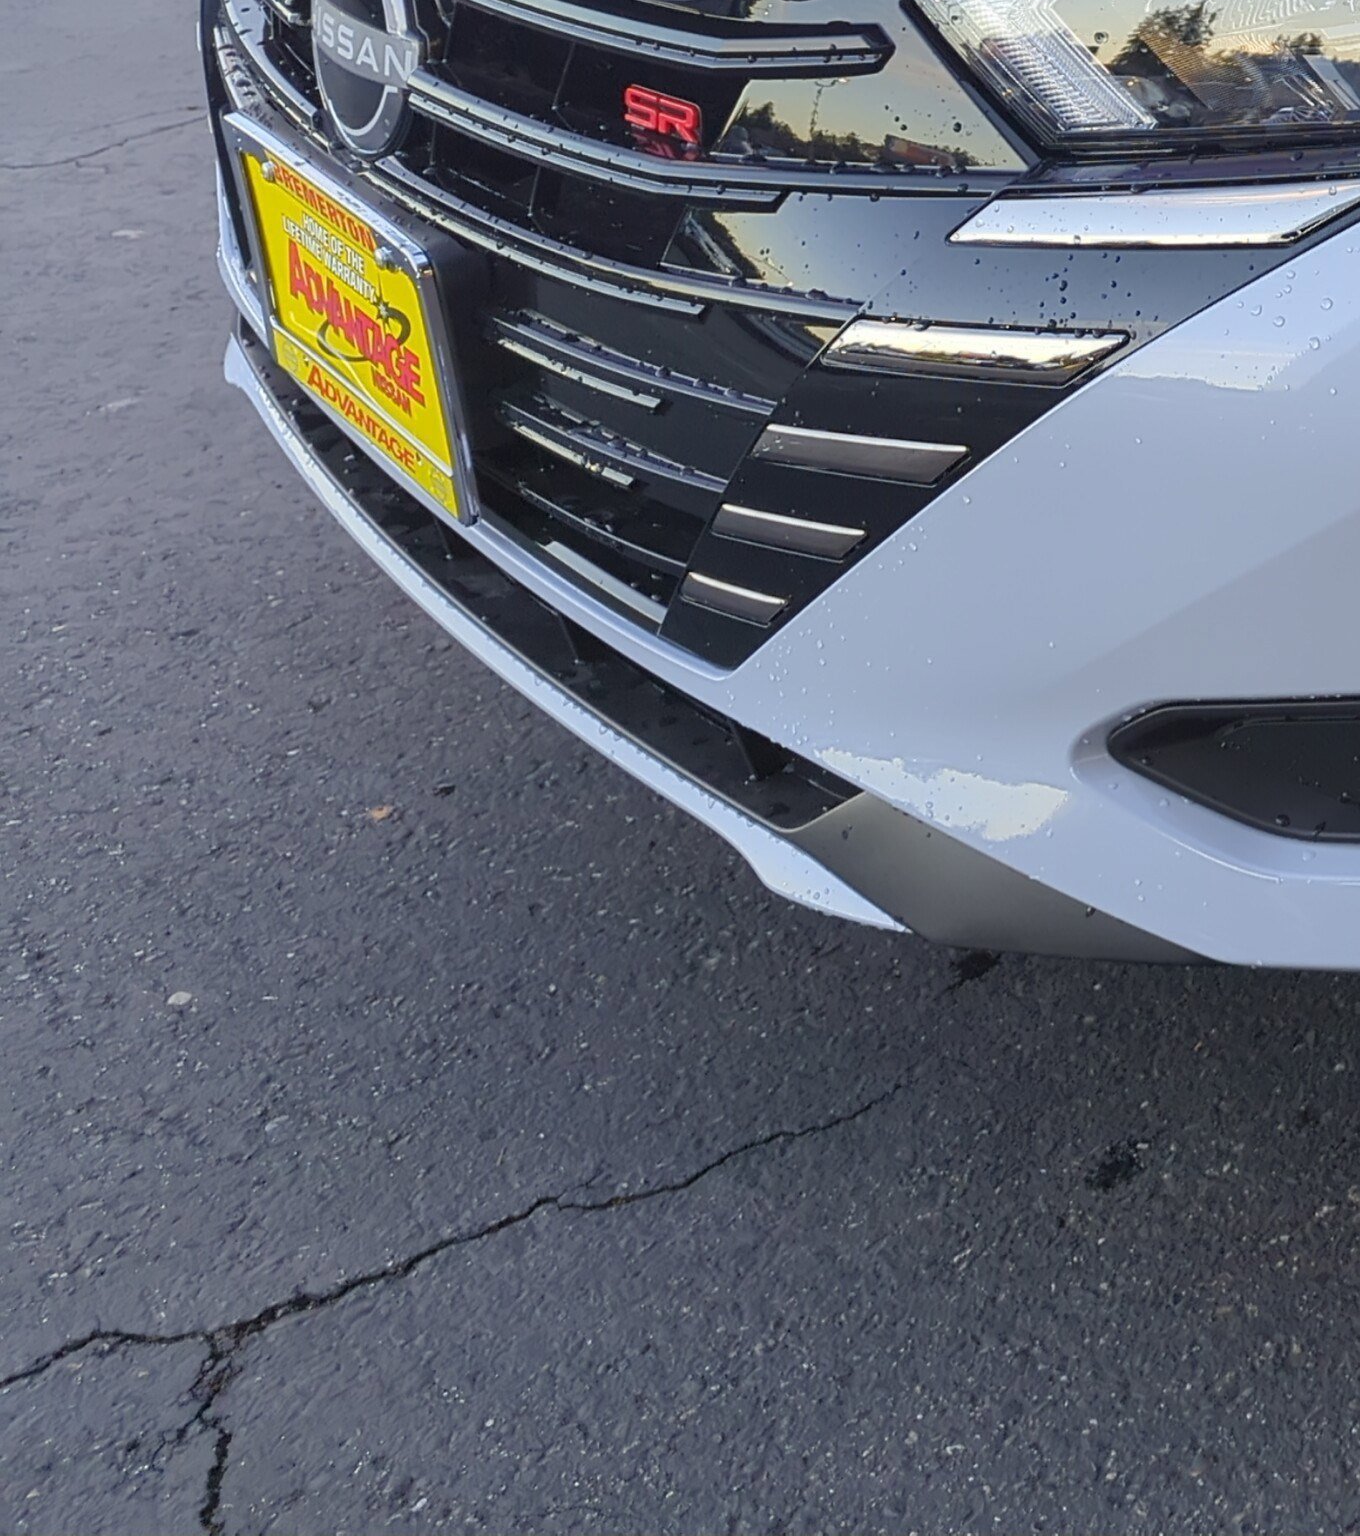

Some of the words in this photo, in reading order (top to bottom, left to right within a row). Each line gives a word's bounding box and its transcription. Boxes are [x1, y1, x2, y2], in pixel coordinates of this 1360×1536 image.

[313, 7, 412, 81] ISSAN
[624, 84, 701, 144] SR
[272, 163, 377, 255] BREMERTON
[281, 212, 323, 263] LIFETIME
[302, 211, 330, 249] HOME
[330, 234, 345, 259] OF
[345, 244, 365, 276] THE
[288, 238, 426, 407] ADVANTAGE
[307, 365, 416, 474] ADVANTAGE
